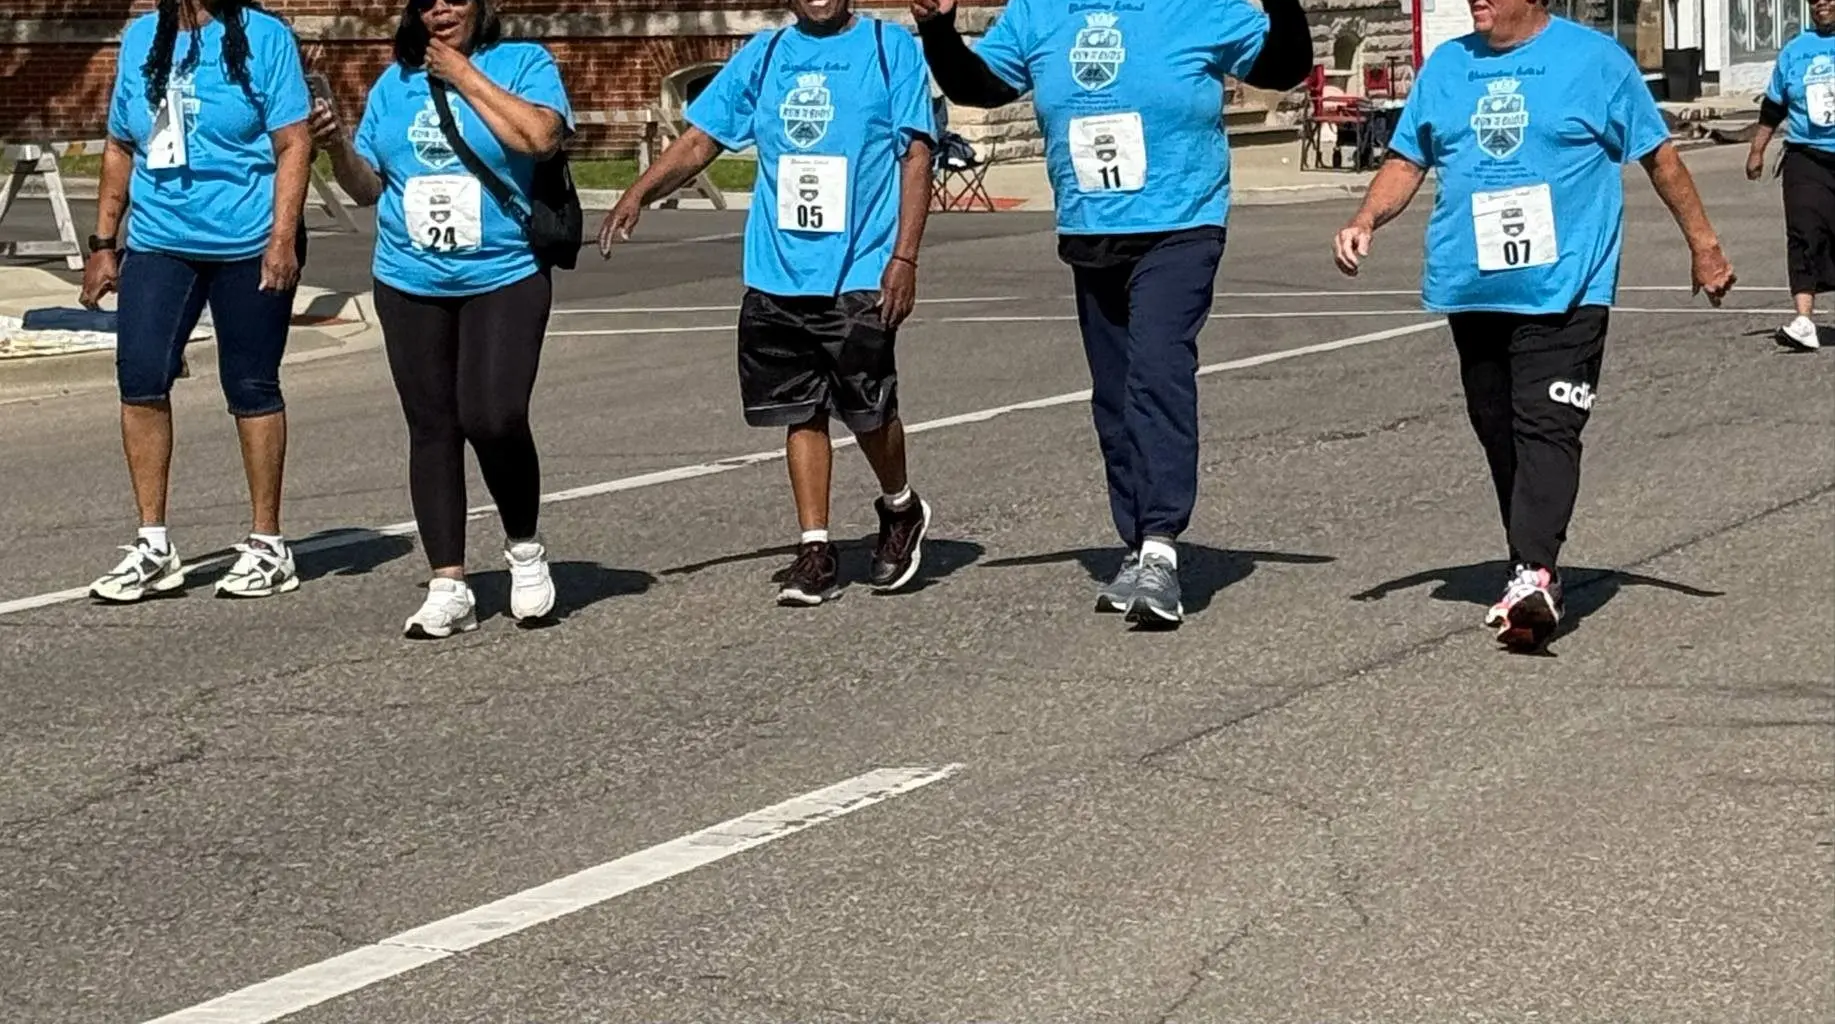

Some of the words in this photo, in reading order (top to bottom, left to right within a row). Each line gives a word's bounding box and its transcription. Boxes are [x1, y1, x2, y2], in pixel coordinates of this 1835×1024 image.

[1823, 109, 1835, 124] 2
[1097, 164, 1122, 190] 11
[797, 203, 824, 229] 05
[427, 226, 458, 252] 24
[1503, 239, 1532, 266] 07
